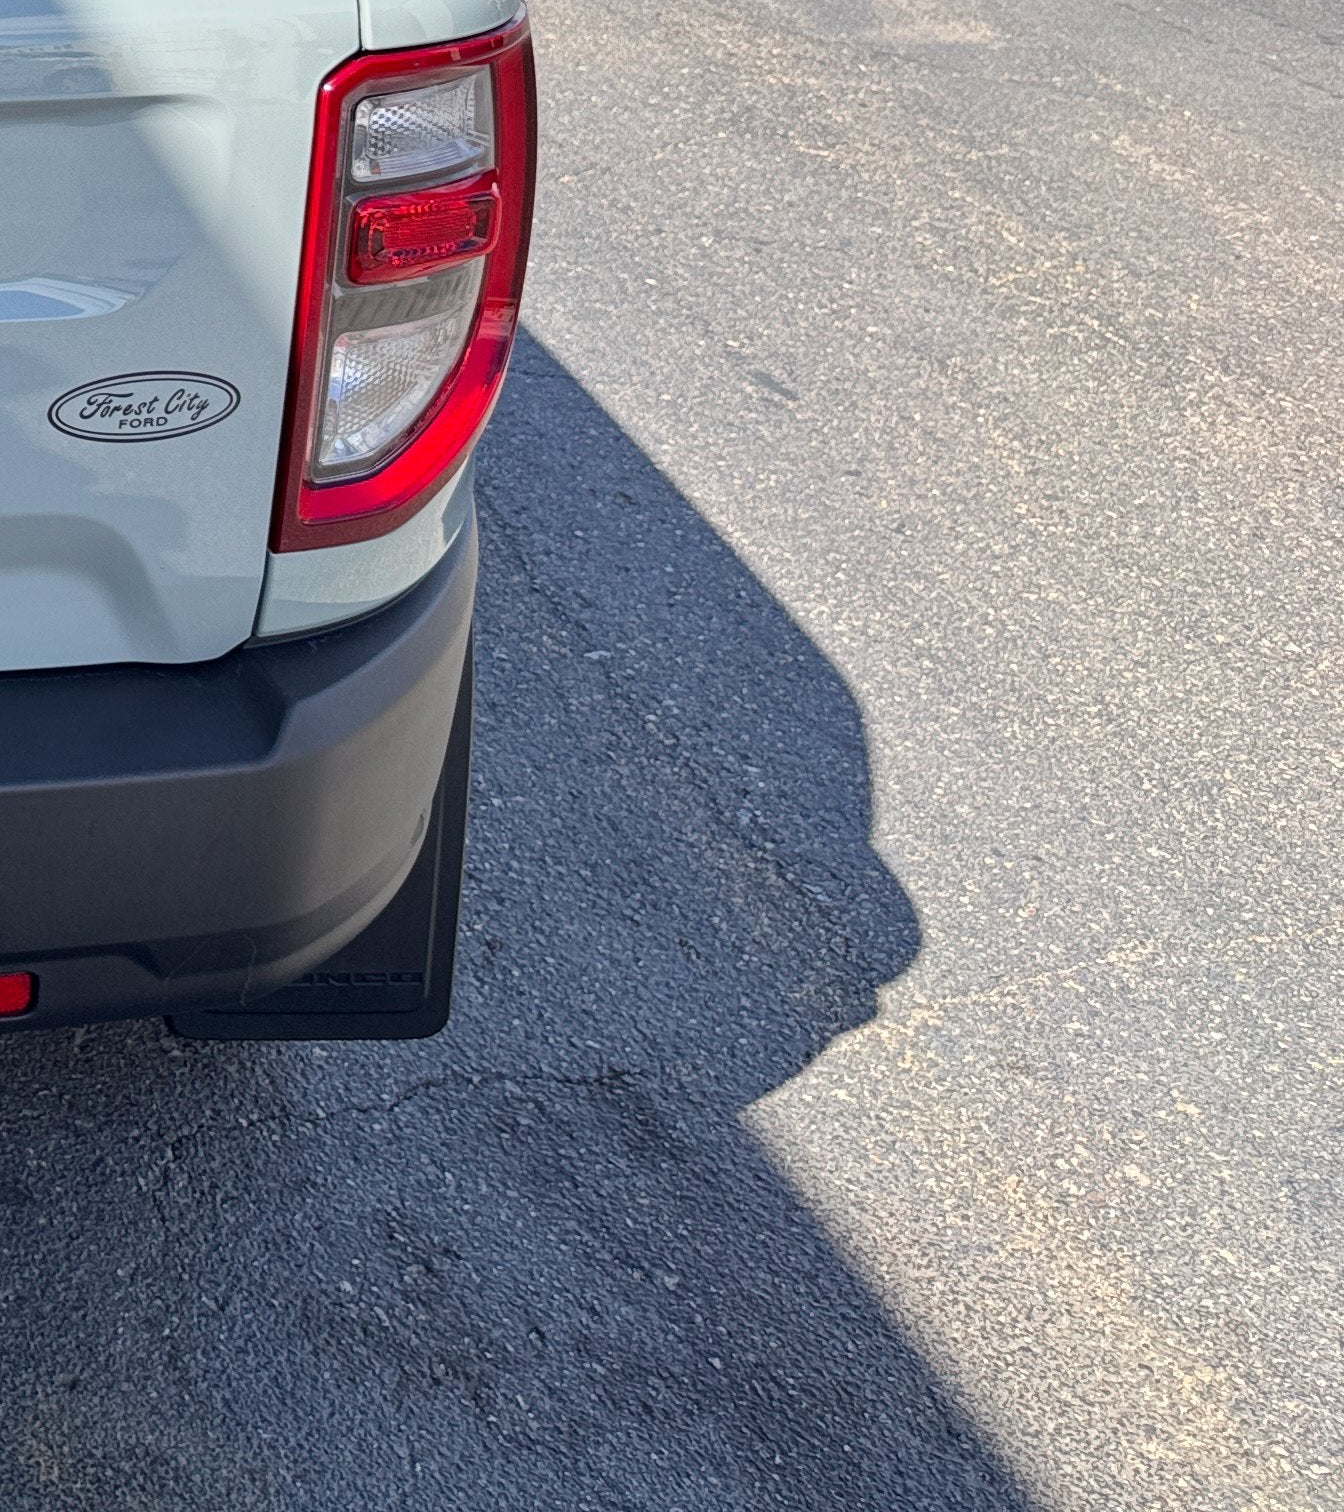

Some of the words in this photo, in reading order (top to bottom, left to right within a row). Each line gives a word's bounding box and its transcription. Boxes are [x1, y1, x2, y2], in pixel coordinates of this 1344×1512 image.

[78, 392, 160, 420] Forest
[163, 388, 210, 421] City
[118, 416, 168, 429] FORD
